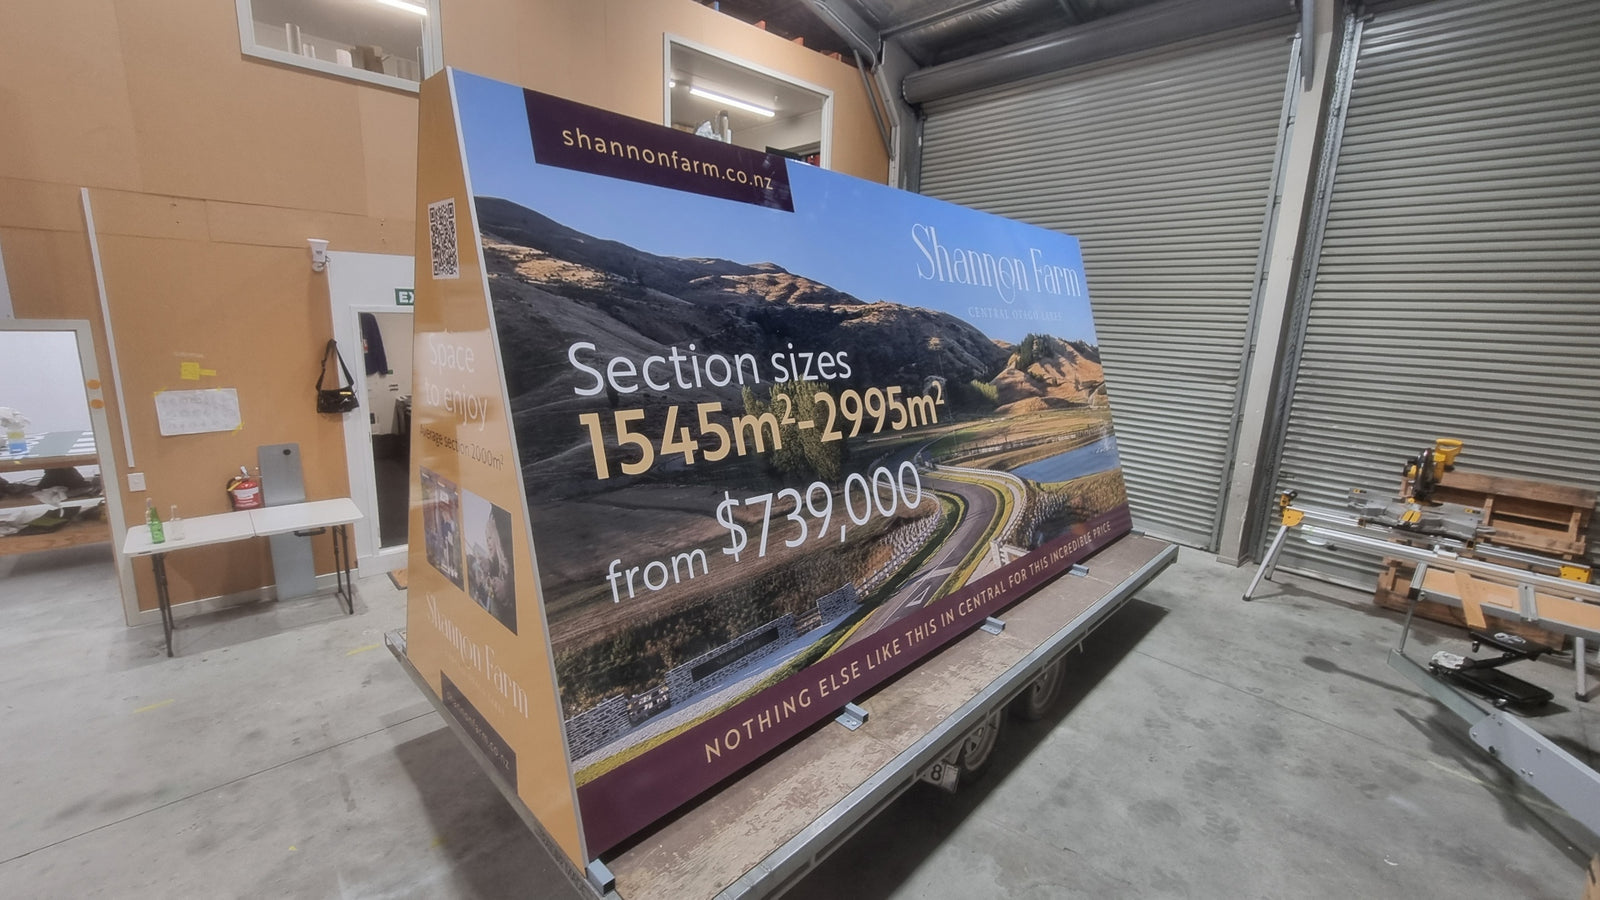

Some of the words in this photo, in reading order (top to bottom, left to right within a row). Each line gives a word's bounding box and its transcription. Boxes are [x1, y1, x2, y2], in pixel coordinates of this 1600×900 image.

[562, 127, 773, 190] shannonfarm.co.nz
[911, 223, 1030, 304] Shannon
[1030, 247, 1081, 296] Farm
[429, 333, 475, 374] Space
[567, 341, 760, 396] Section
[771, 342, 852, 383] sizes
[424, 378, 440, 407] to
[444, 384, 488, 431] enjoy
[606, 548, 709, 604] from
[716, 460, 922, 562] $739,000
[704, 688, 811, 764] NOTHING
[818, 660, 861, 698] ELSE
[866, 638, 901, 671] LIKE
[905, 618, 937, 648] THIS
[941, 609, 955, 628] IN
[958, 582, 1007, 617] CENTRAL
[1008, 569, 1028, 589] FOR
[1028, 556, 1049, 577] THIS
[1050, 533, 1093, 565] INCREDIBLE
[1092, 520, 1112, 542] PRICE
[485, 644, 528, 719] Farm
